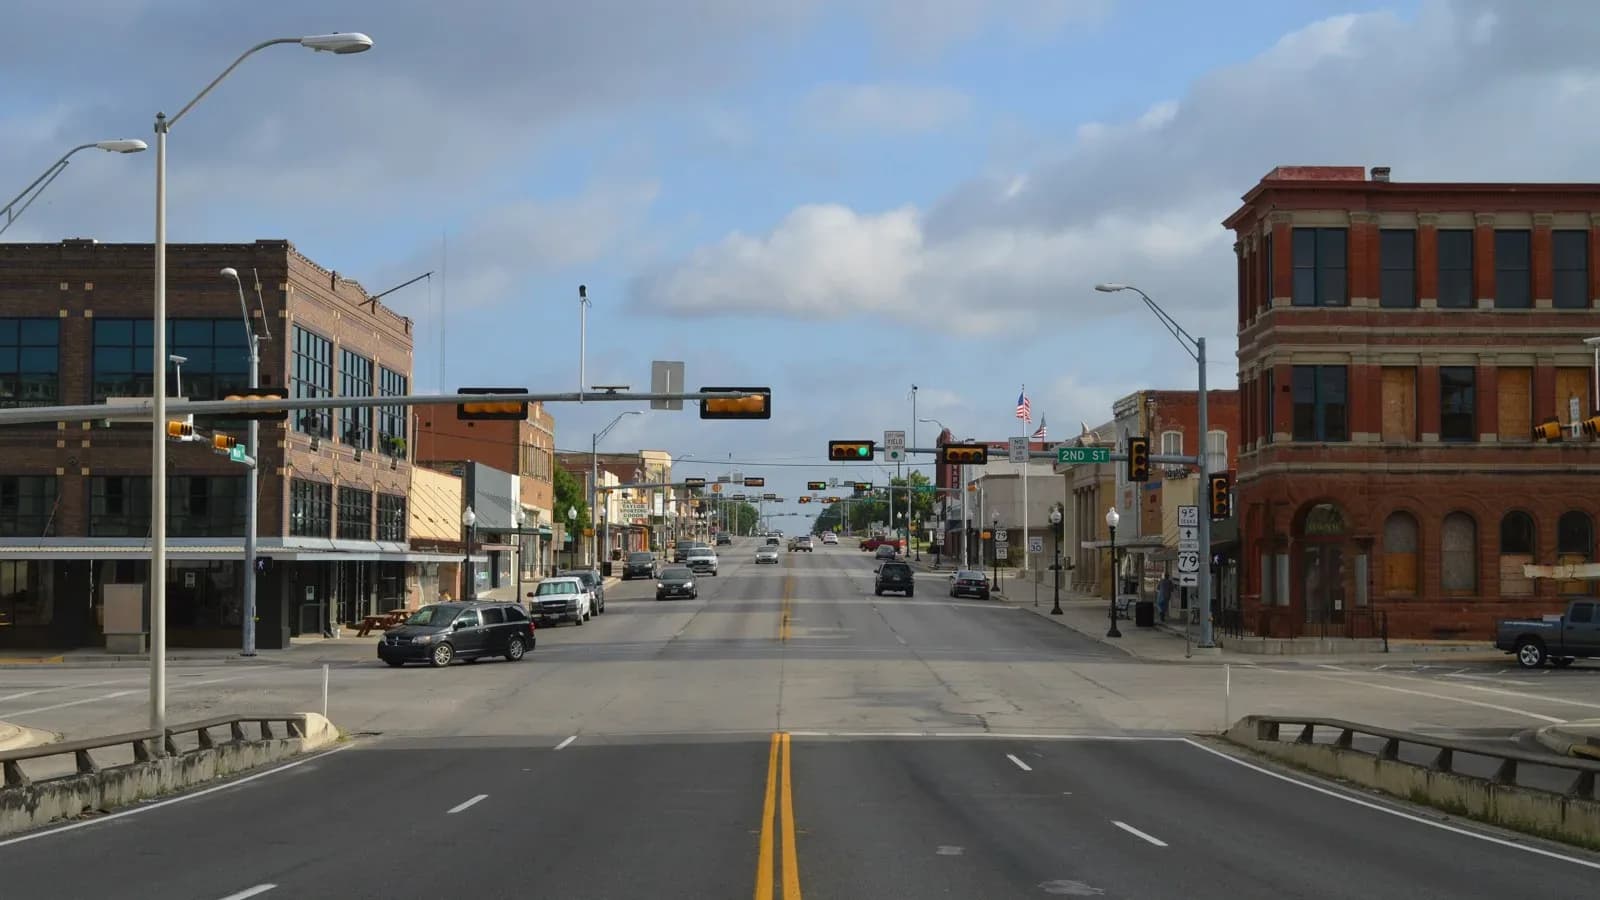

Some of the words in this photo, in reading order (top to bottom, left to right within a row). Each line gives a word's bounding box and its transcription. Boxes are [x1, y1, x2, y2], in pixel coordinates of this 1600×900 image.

[1062, 450, 1085, 461] 2ND
[1092, 450, 1106, 461] ST
[1181, 508, 1196, 518] 95
[1031, 544, 1042, 552] 30
[1180, 555, 1197, 568] 79
